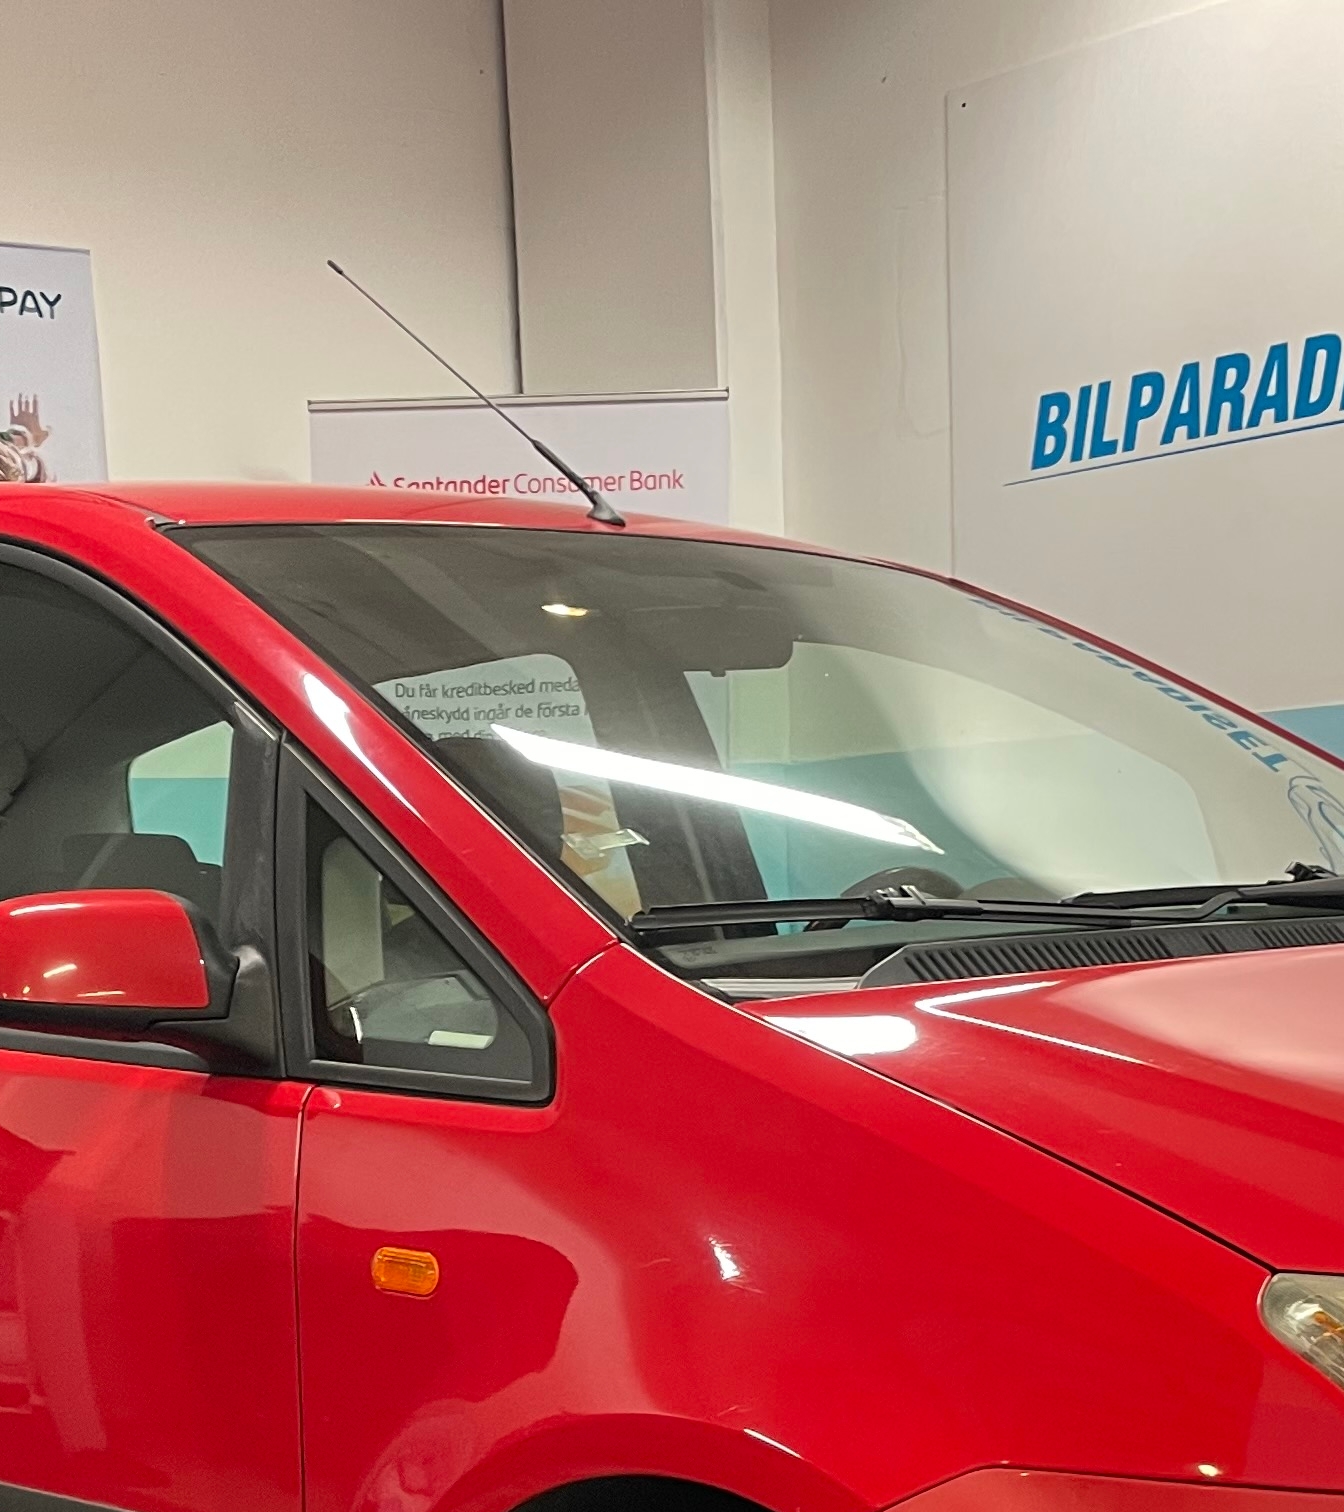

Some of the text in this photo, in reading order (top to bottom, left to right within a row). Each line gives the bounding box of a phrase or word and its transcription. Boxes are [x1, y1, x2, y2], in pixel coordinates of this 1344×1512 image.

[629, 468, 684, 491] Bank
[394, 682, 415, 698] Du
[419, 683, 438, 698] får
[441, 678, 536, 698] kreditbesked
[402, 702, 580, 724] åneskydd ingår de första
